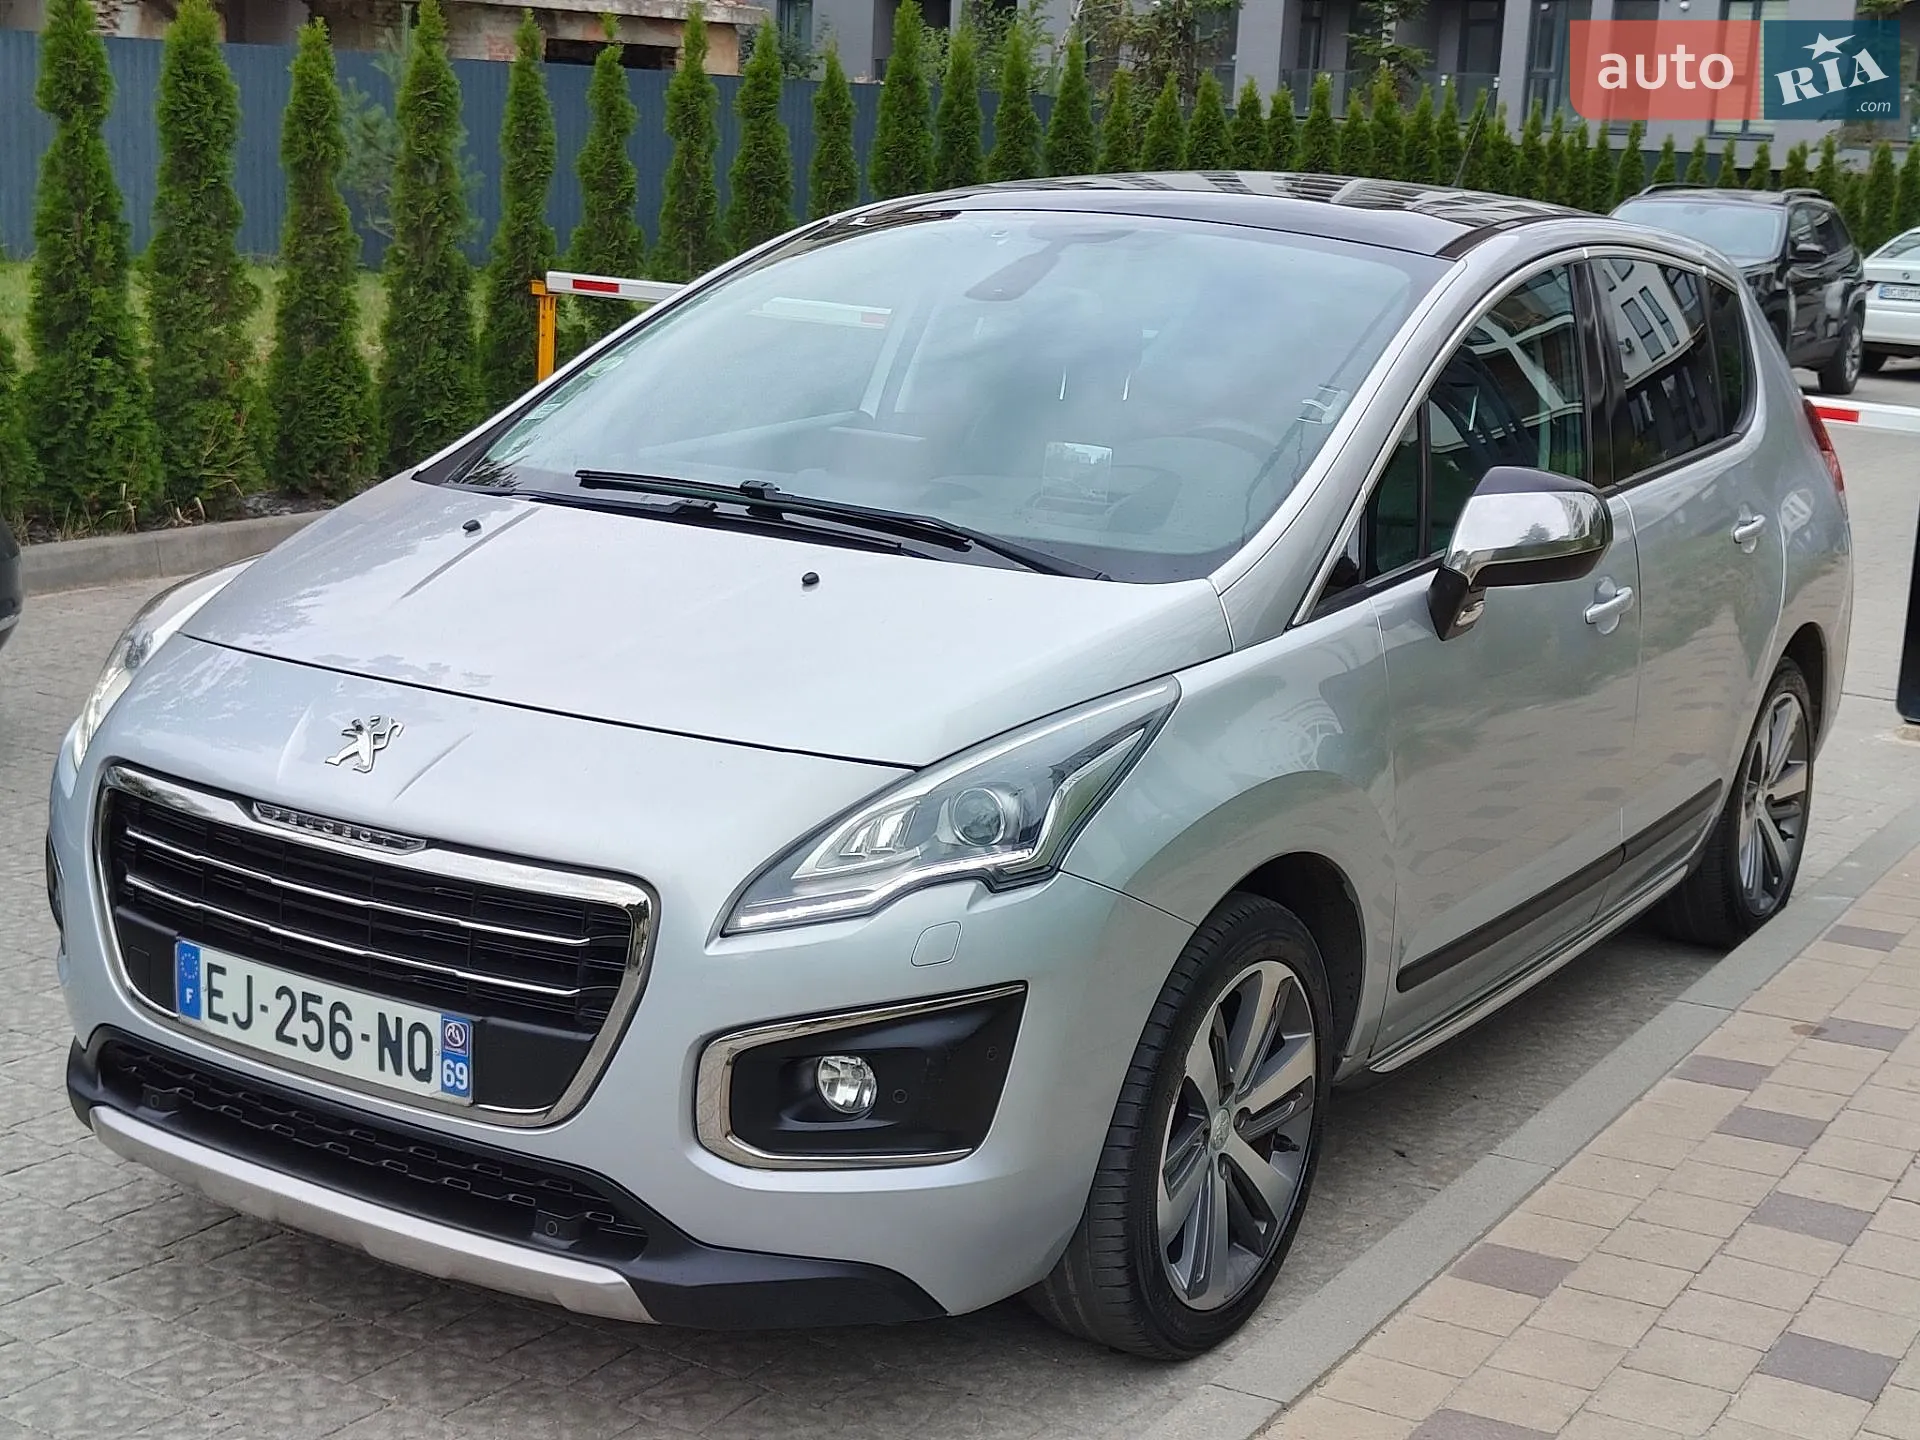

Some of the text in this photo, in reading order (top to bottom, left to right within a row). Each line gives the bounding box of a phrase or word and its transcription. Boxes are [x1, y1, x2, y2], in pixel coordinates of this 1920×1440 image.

[185, 988, 194, 1004] F
[206, 961, 434, 1084] EJ-256-NQ
[442, 1058, 468, 1091] 69
